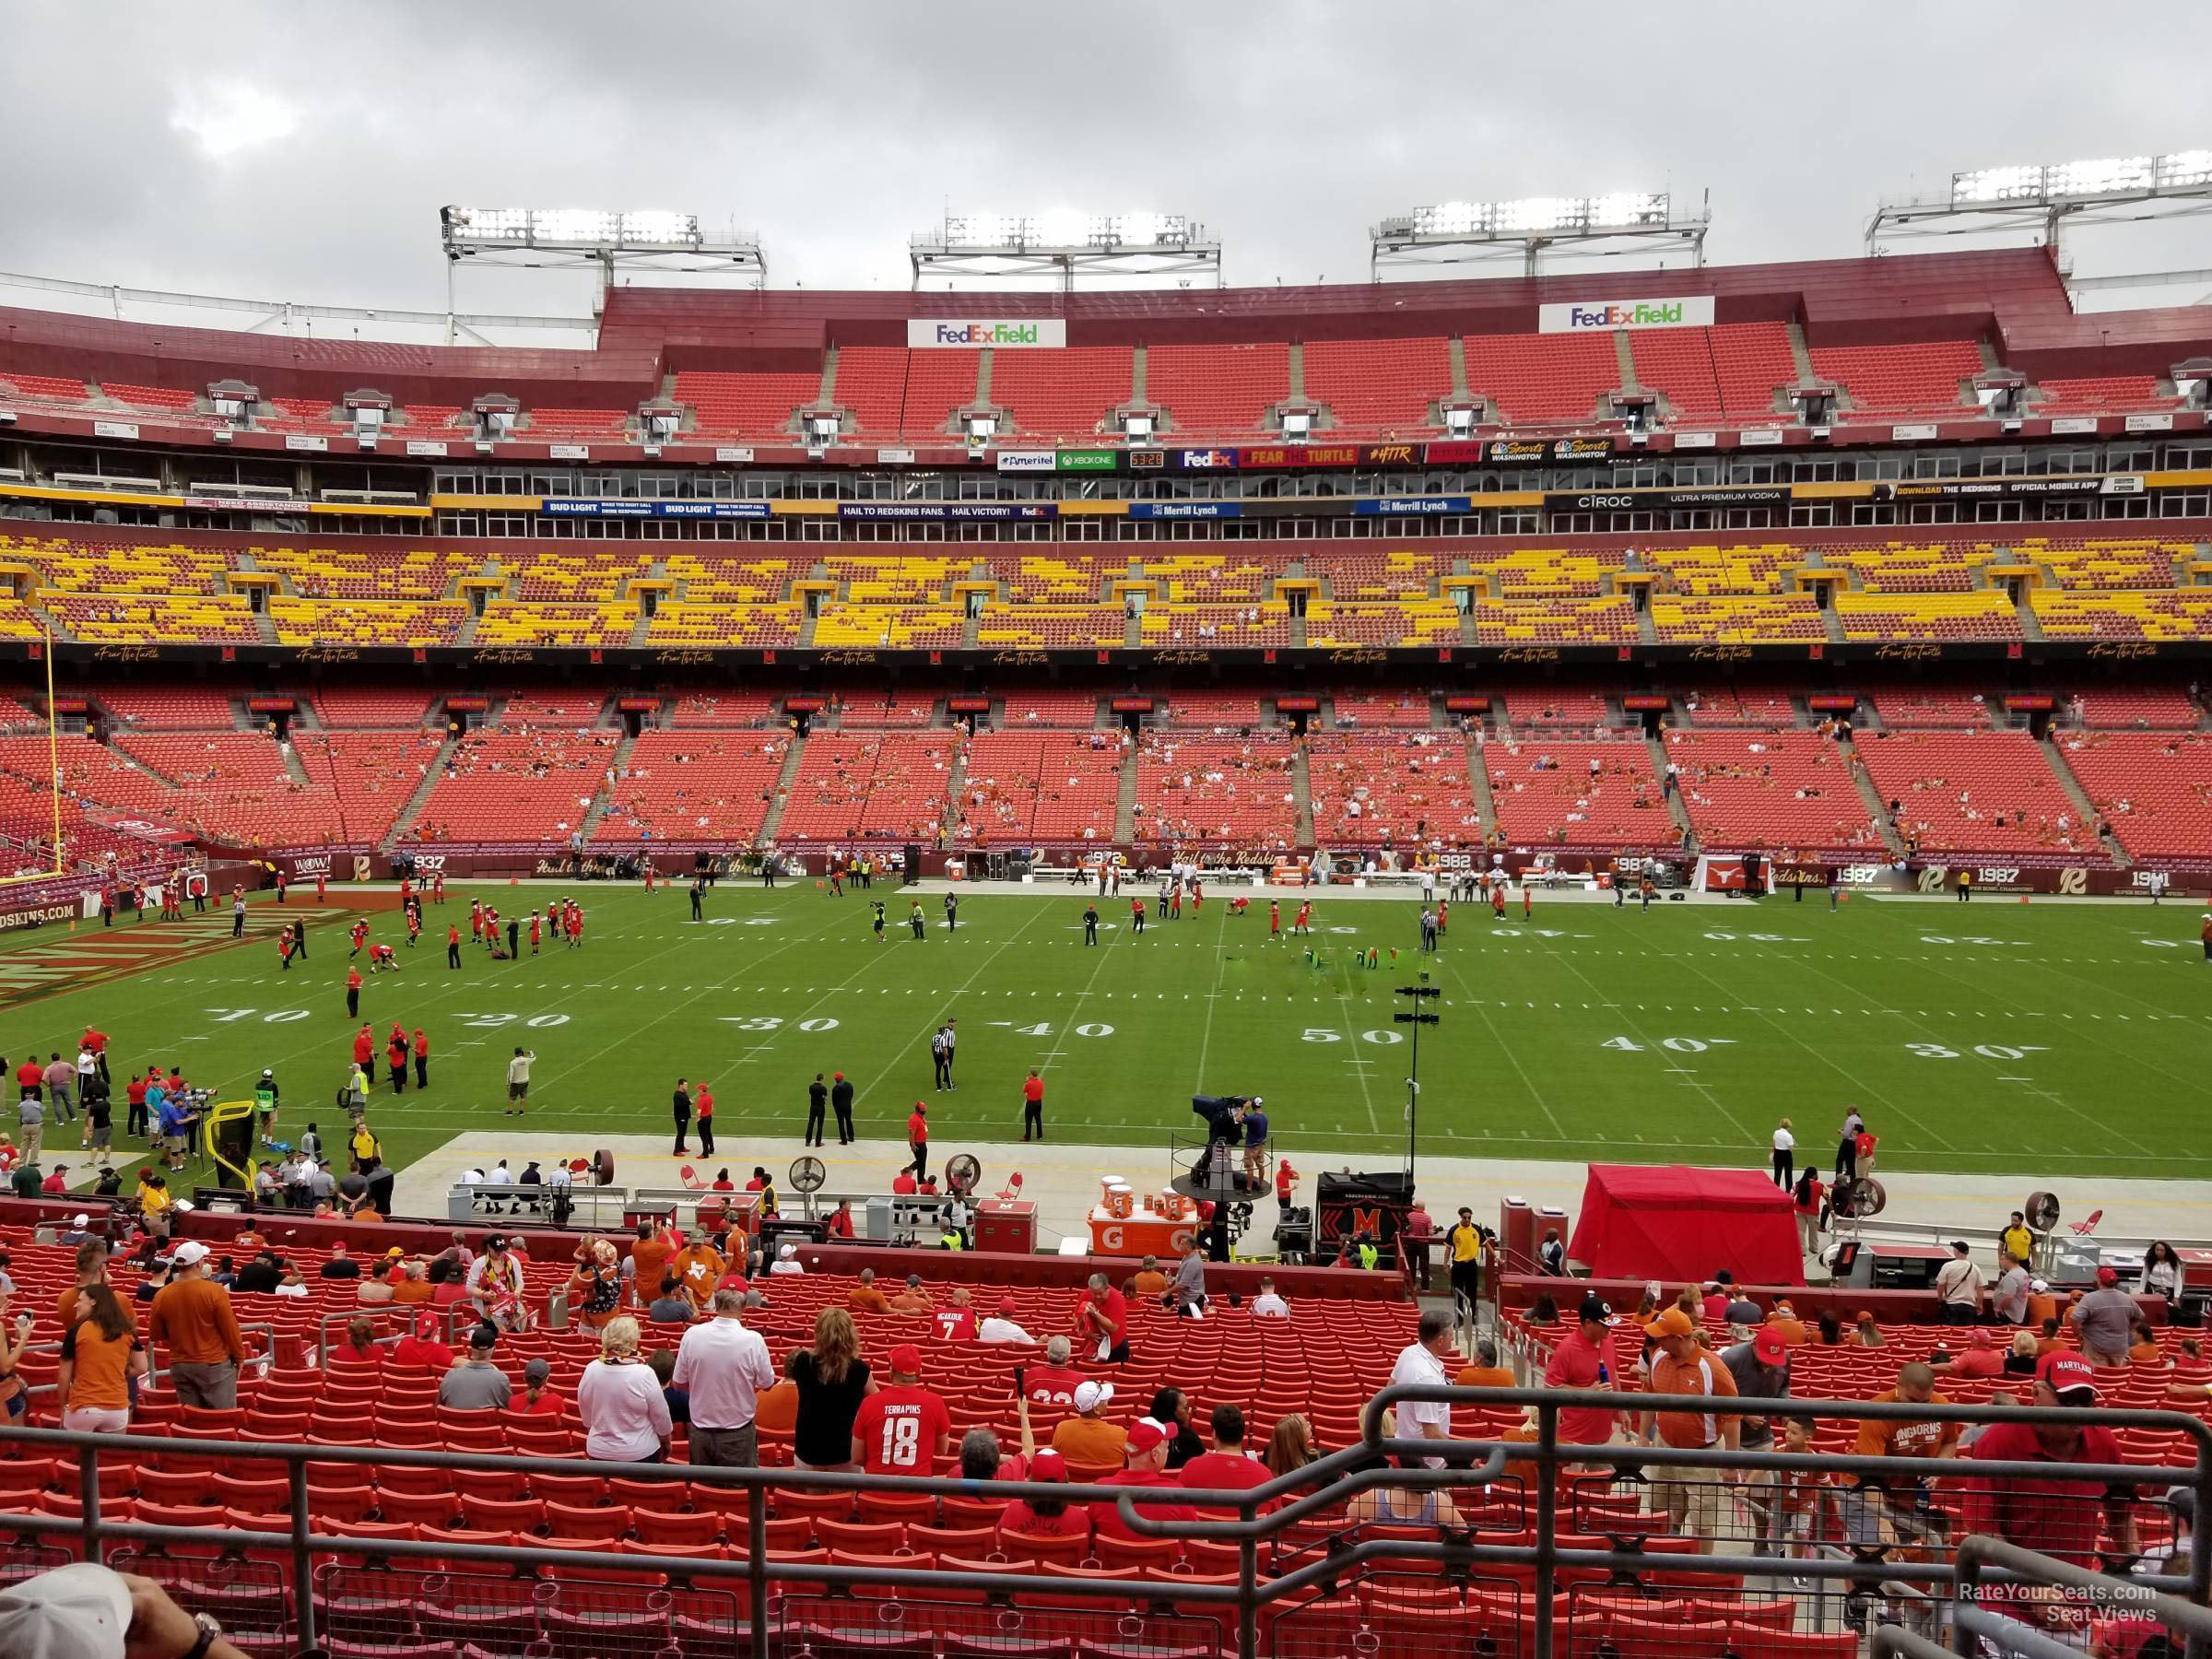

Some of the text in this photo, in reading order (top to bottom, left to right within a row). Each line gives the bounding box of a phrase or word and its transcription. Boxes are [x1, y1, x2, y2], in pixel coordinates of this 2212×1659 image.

[1571, 302, 1682, 327] FedExField
[936, 324, 1037, 344] FedExField
[1508, 442, 1546, 454] Sports
[1571, 439, 1609, 452] Sports
[1010, 455, 1053, 465] Ameritel
[1073, 456, 1112, 465] XBOX ONE
[1184, 451, 1230, 467] FedEx
[1897, 481, 2099, 495] DOWNLOAD THE REDSKINS OFFICIAL MOBILE APP
[550, 503, 598, 512] BUD LIGHT
[685, 505, 712, 513] LIGHT
[844, 507, 1010, 516] HAIL TO REDSKINS FANS. HAIL VICTORY!
[1164, 506, 1192, 516] Merrill
[1193, 506, 1218, 516] Lynch
[1392, 501, 1420, 511] Merrill
[1422, 500, 1448, 512] Lynch
[294, 853, 331, 870] WOW!
[1440, 854, 1471, 868] 982
[1613, 857, 1646, 872] 198
[1836, 867, 1878, 883] 1987
[1978, 868, 2020, 884] 1987
[2132, 871, 2170, 887] 191
[462, 1013, 571, 1027] 20
[737, 1017, 840, 1031] 30
[1014, 1022, 1115, 1037] 40
[1300, 1028, 1404, 1044] 50
[1600, 1036, 1708, 1053] 40
[1904, 1042, 2025, 1060] 30
[1353, 1207, 1386, 1241] M
[942, 1321, 955, 1339] 7
[884, 1404, 921, 1415] TERRAPINS
[881, 1417, 920, 1465] 18
